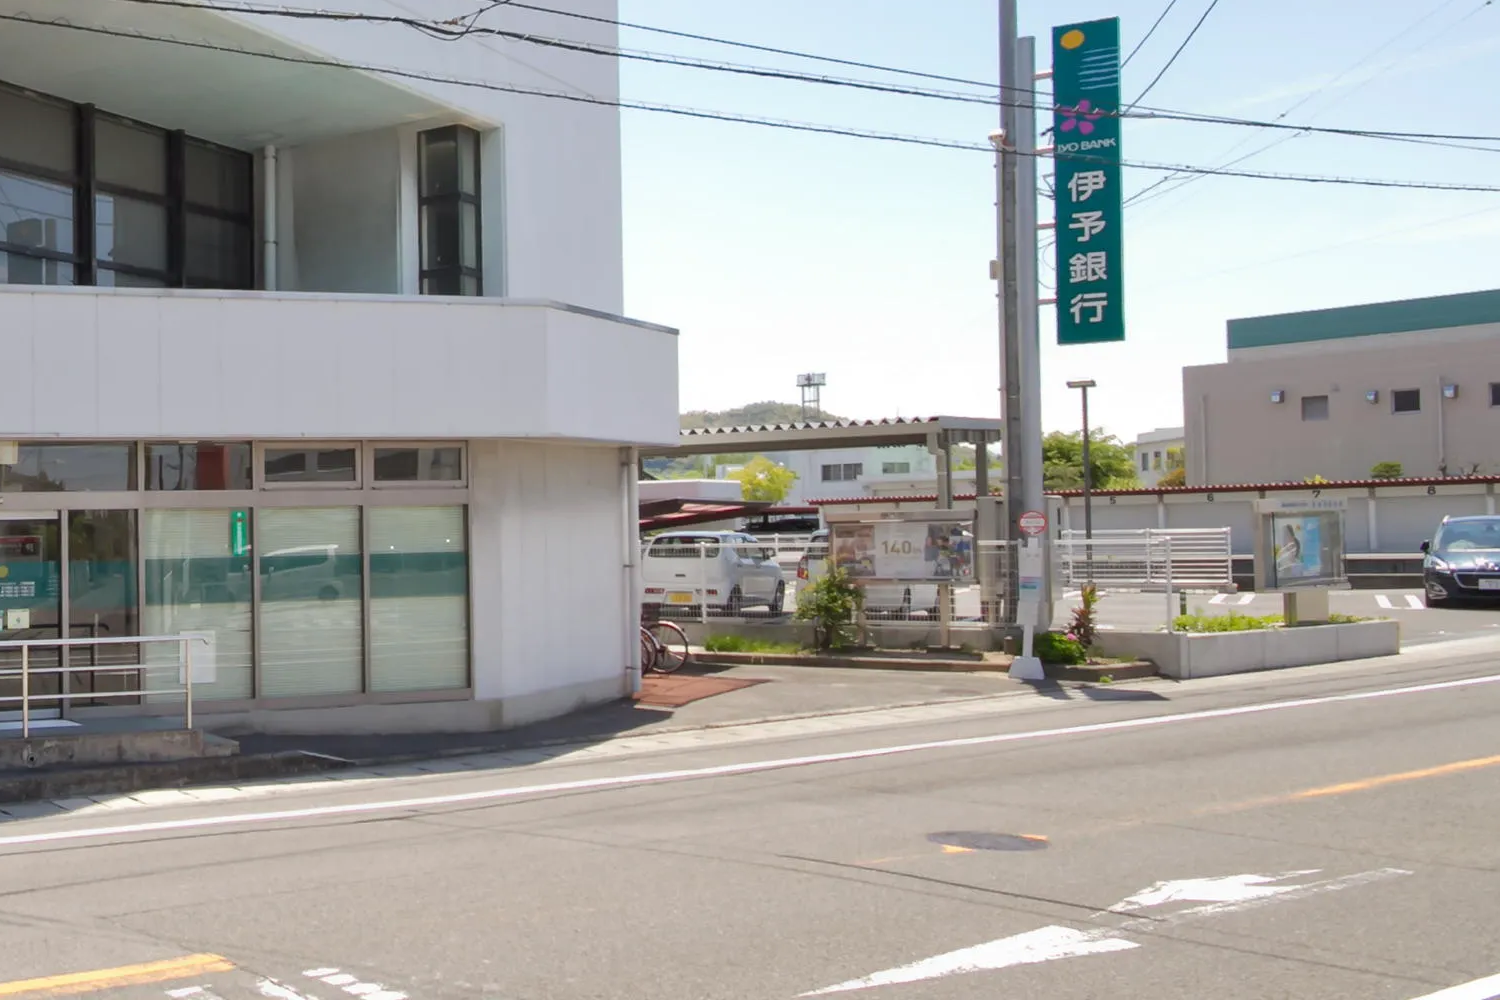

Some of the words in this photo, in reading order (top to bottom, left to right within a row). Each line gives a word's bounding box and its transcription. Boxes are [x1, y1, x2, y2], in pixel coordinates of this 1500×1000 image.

[1057, 142, 1079, 153] IYO
[1080, 137, 1117, 151] BANK
[1067, 169, 1108, 325] 伊予銀行
[1109, 495, 1117, 505] 5
[1206, 492, 1214, 503] 6
[1312, 489, 1321, 498] 7
[881, 540, 912, 555] 140
